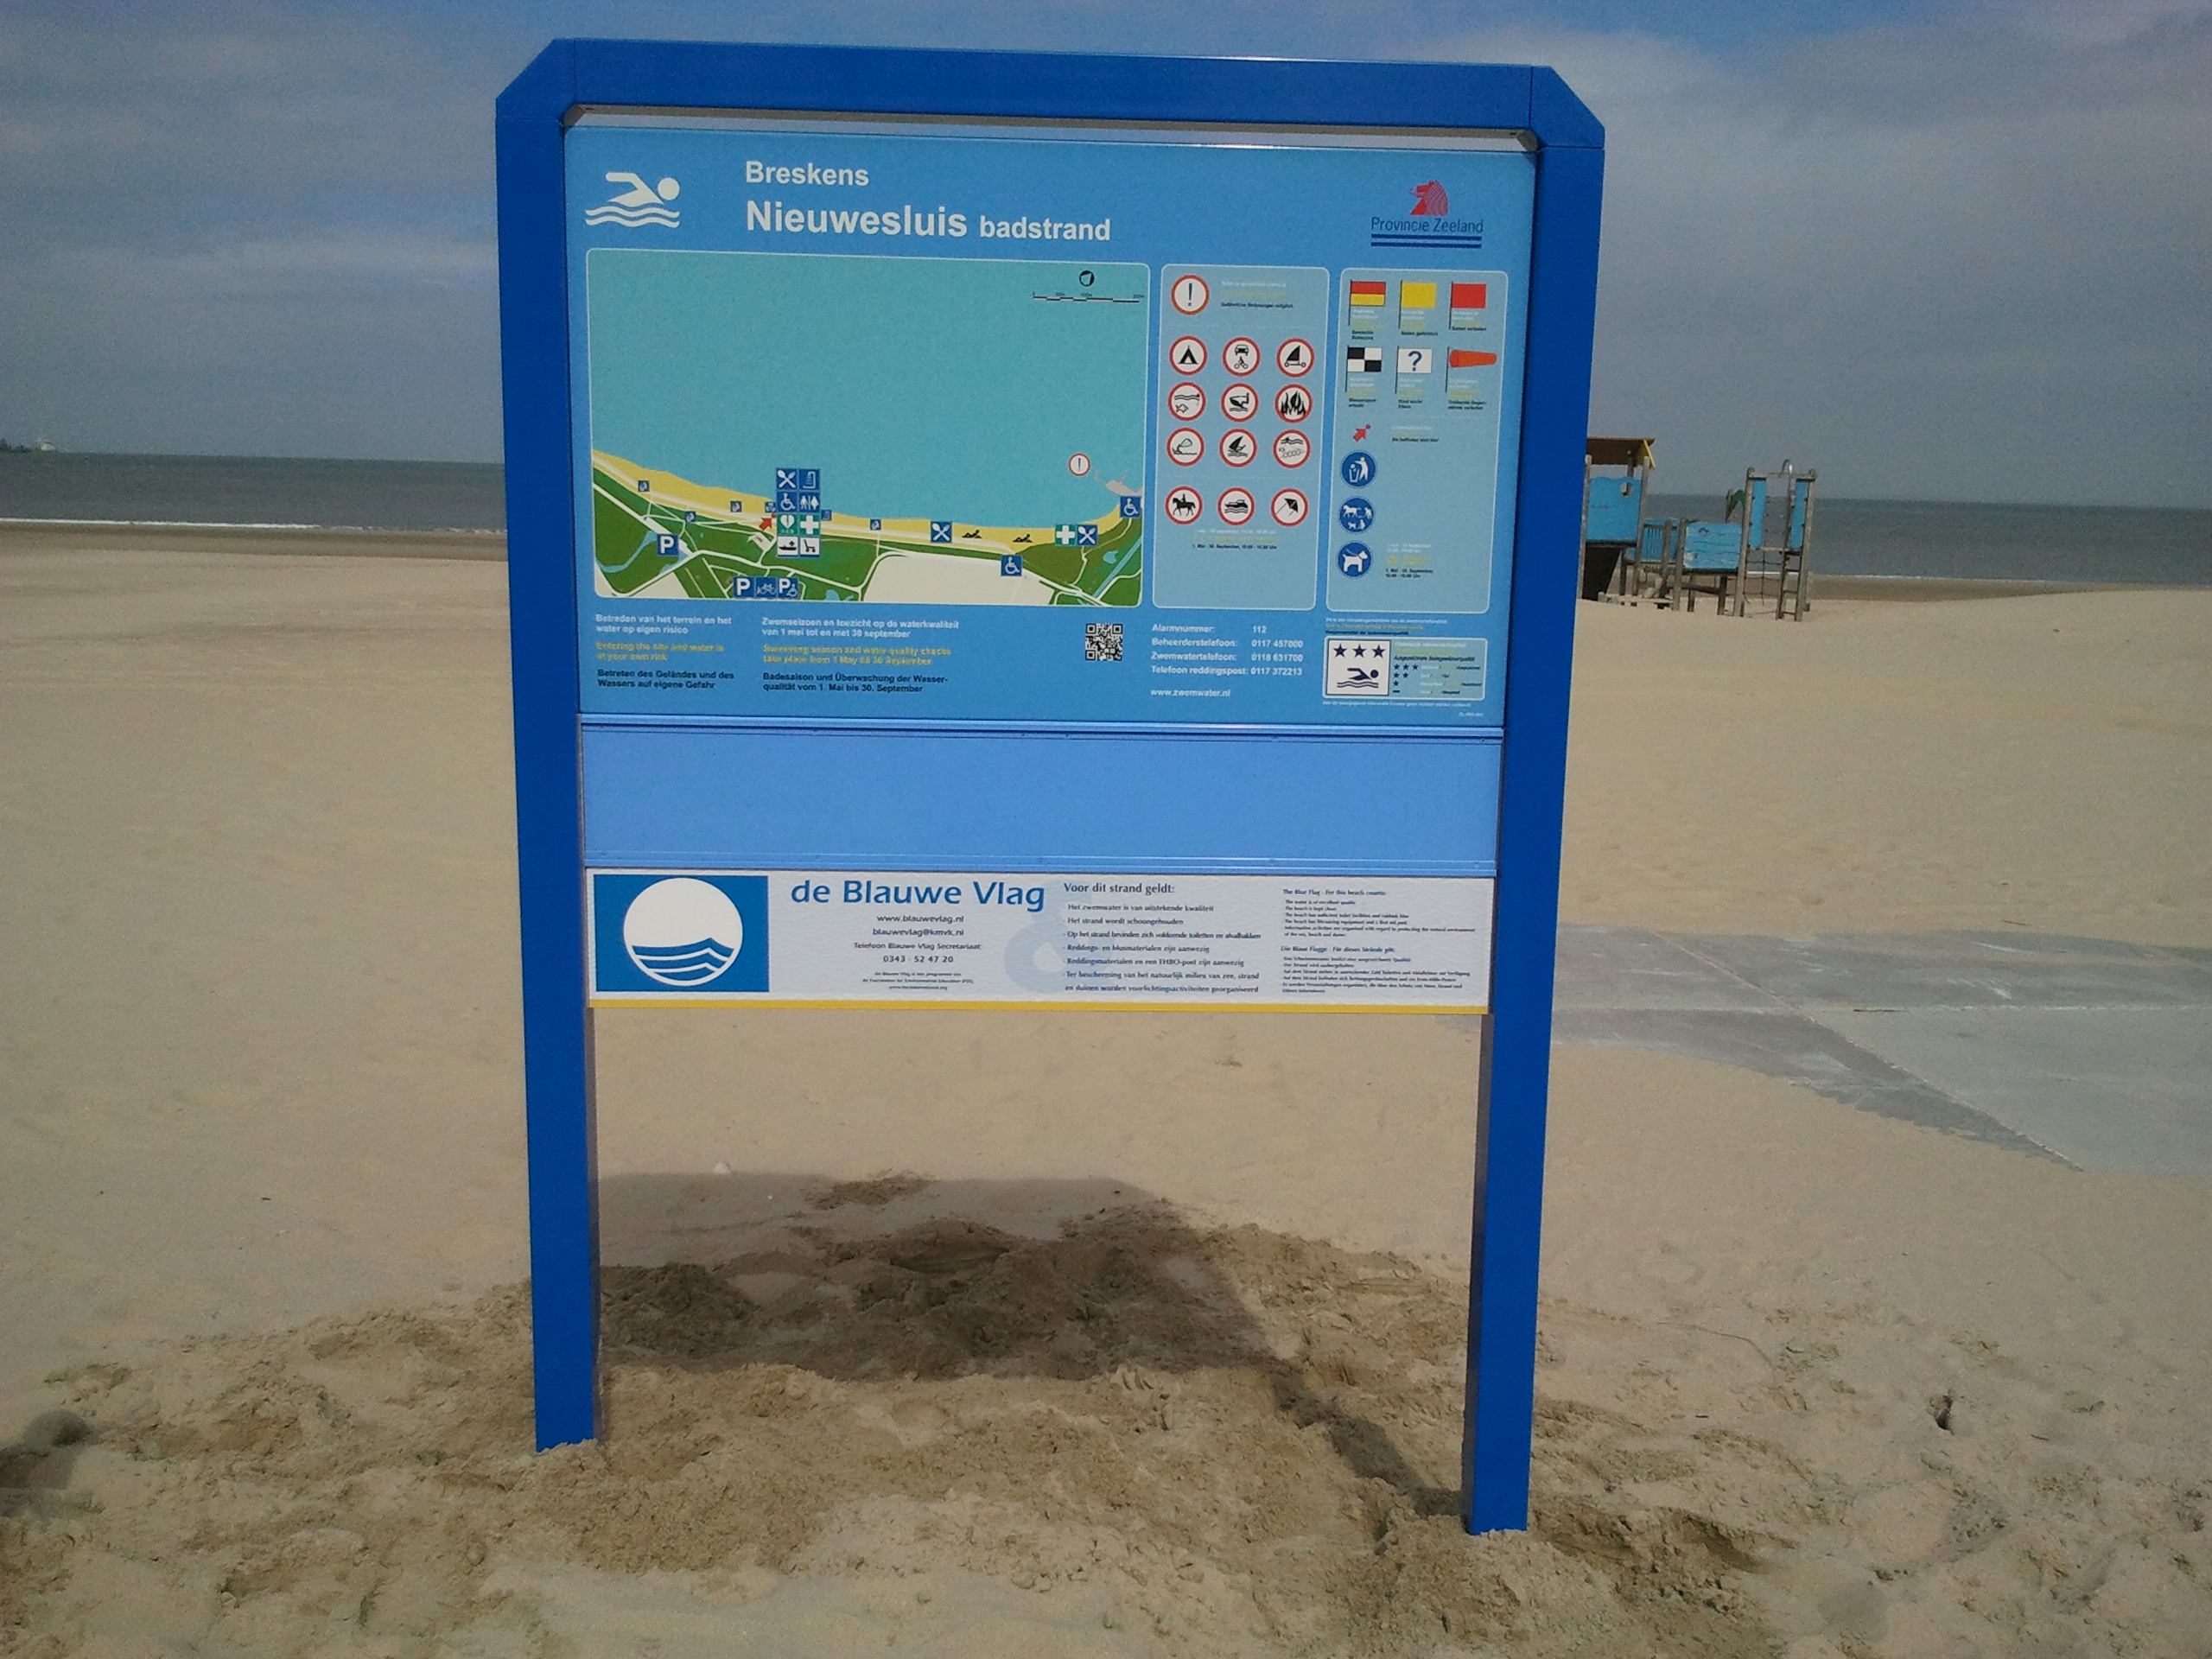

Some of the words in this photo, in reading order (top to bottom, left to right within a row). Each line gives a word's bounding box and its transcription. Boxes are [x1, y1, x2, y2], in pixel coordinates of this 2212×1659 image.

[746, 161, 868, 188] Breskens
[747, 200, 967, 237] Nieuwesluis
[980, 215, 1111, 242] badstrand
[1371, 217, 1430, 232] Provincie
[1433, 218, 1484, 233] Zeeland
[762, 617, 821, 626] Zwemseizoen
[836, 619, 871, 627] toezicht
[637, 626, 661, 634] eigen
[1152, 624, 1216, 633] Alarmnummer:
[864, 630, 911, 639] september
[1151, 638, 1237, 647] Beheerderstelefoon:
[1273, 639, 1303, 648] 457000
[1151, 652, 1237, 661] Zwemwatertelefoon:
[1151, 665, 1187, 674] Telefoon
[1189, 665, 1249, 677] reddingspost:
[1272, 667, 1302, 676] 372213
[763, 672, 814, 681] Badesaison
[836, 672, 894, 683] Überwachung
[877, 684, 923, 693] September
[1064, 883, 1089, 893] Voor
[1092, 882, 1106, 893] dit
[1109, 883, 1142, 893] strand
[1145, 883, 1175, 895] geldt:
[791, 880, 830, 903] de
[843, 880, 962, 904] Blauwe
[973, 880, 1045, 912] Vlag
[877, 914, 963, 924] www.blauwevlag.nl
[917, 943, 935, 951] Vlag
[942, 955, 954, 963] 20
